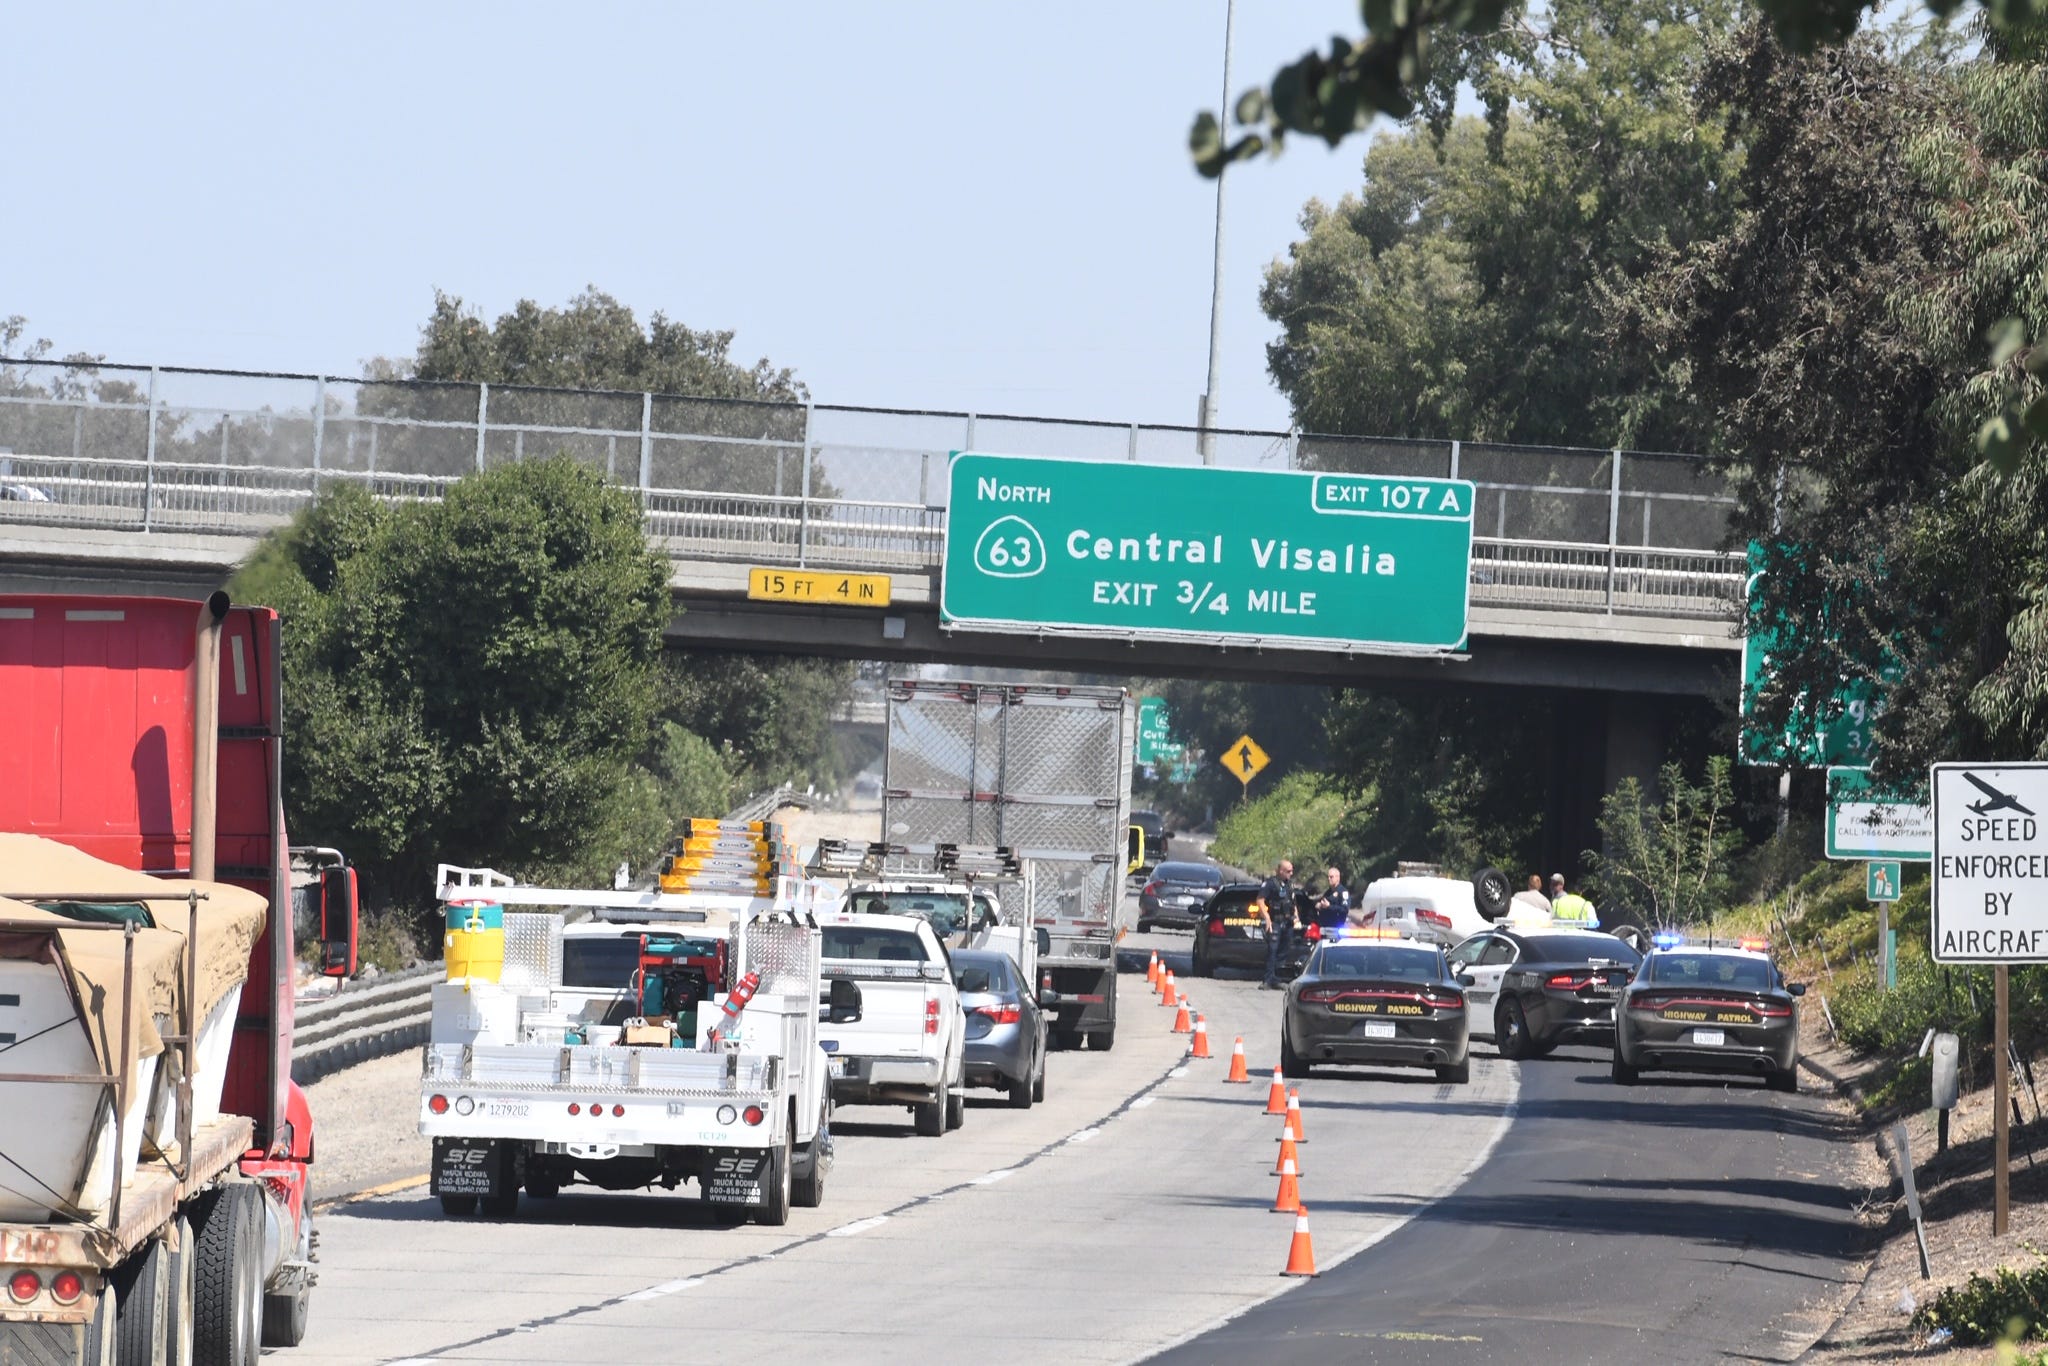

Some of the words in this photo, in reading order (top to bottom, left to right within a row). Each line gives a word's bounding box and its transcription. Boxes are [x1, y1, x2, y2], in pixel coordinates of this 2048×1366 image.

[1325, 484, 1369, 503] EXIT
[1381, 485, 1430, 510] 107
[1438, 488, 1460, 512] A
[989, 536, 1031, 567] 63
[1066, 529, 1222, 564] Central
[1251, 538, 1395, 576] Visalia
[763, 575, 785, 594] 15
[794, 580, 814, 595] FT
[837, 579, 849, 597] 4
[859, 583, 873, 598] IN
[1093, 581, 1158, 606] EXIT
[1176, 580, 1230, 615] 3/4
[1247, 589, 1316, 615] MILE
[1838, 828, 1858, 836] CALL
[1961, 818, 2037, 842] SPEED
[1984, 892, 2013, 915] BY
[1224, 917, 1261, 926] HIGHWAY
[1335, 1003, 1378, 1013] HIGHWAY
[1387, 1005, 1423, 1014] PATROL
[1664, 1010, 1707, 1021] HIGHWAY
[1717, 1013, 1753, 1023] PATROL
[443, 1149, 488, 1164] SE
[714, 1157, 759, 1173] SE
